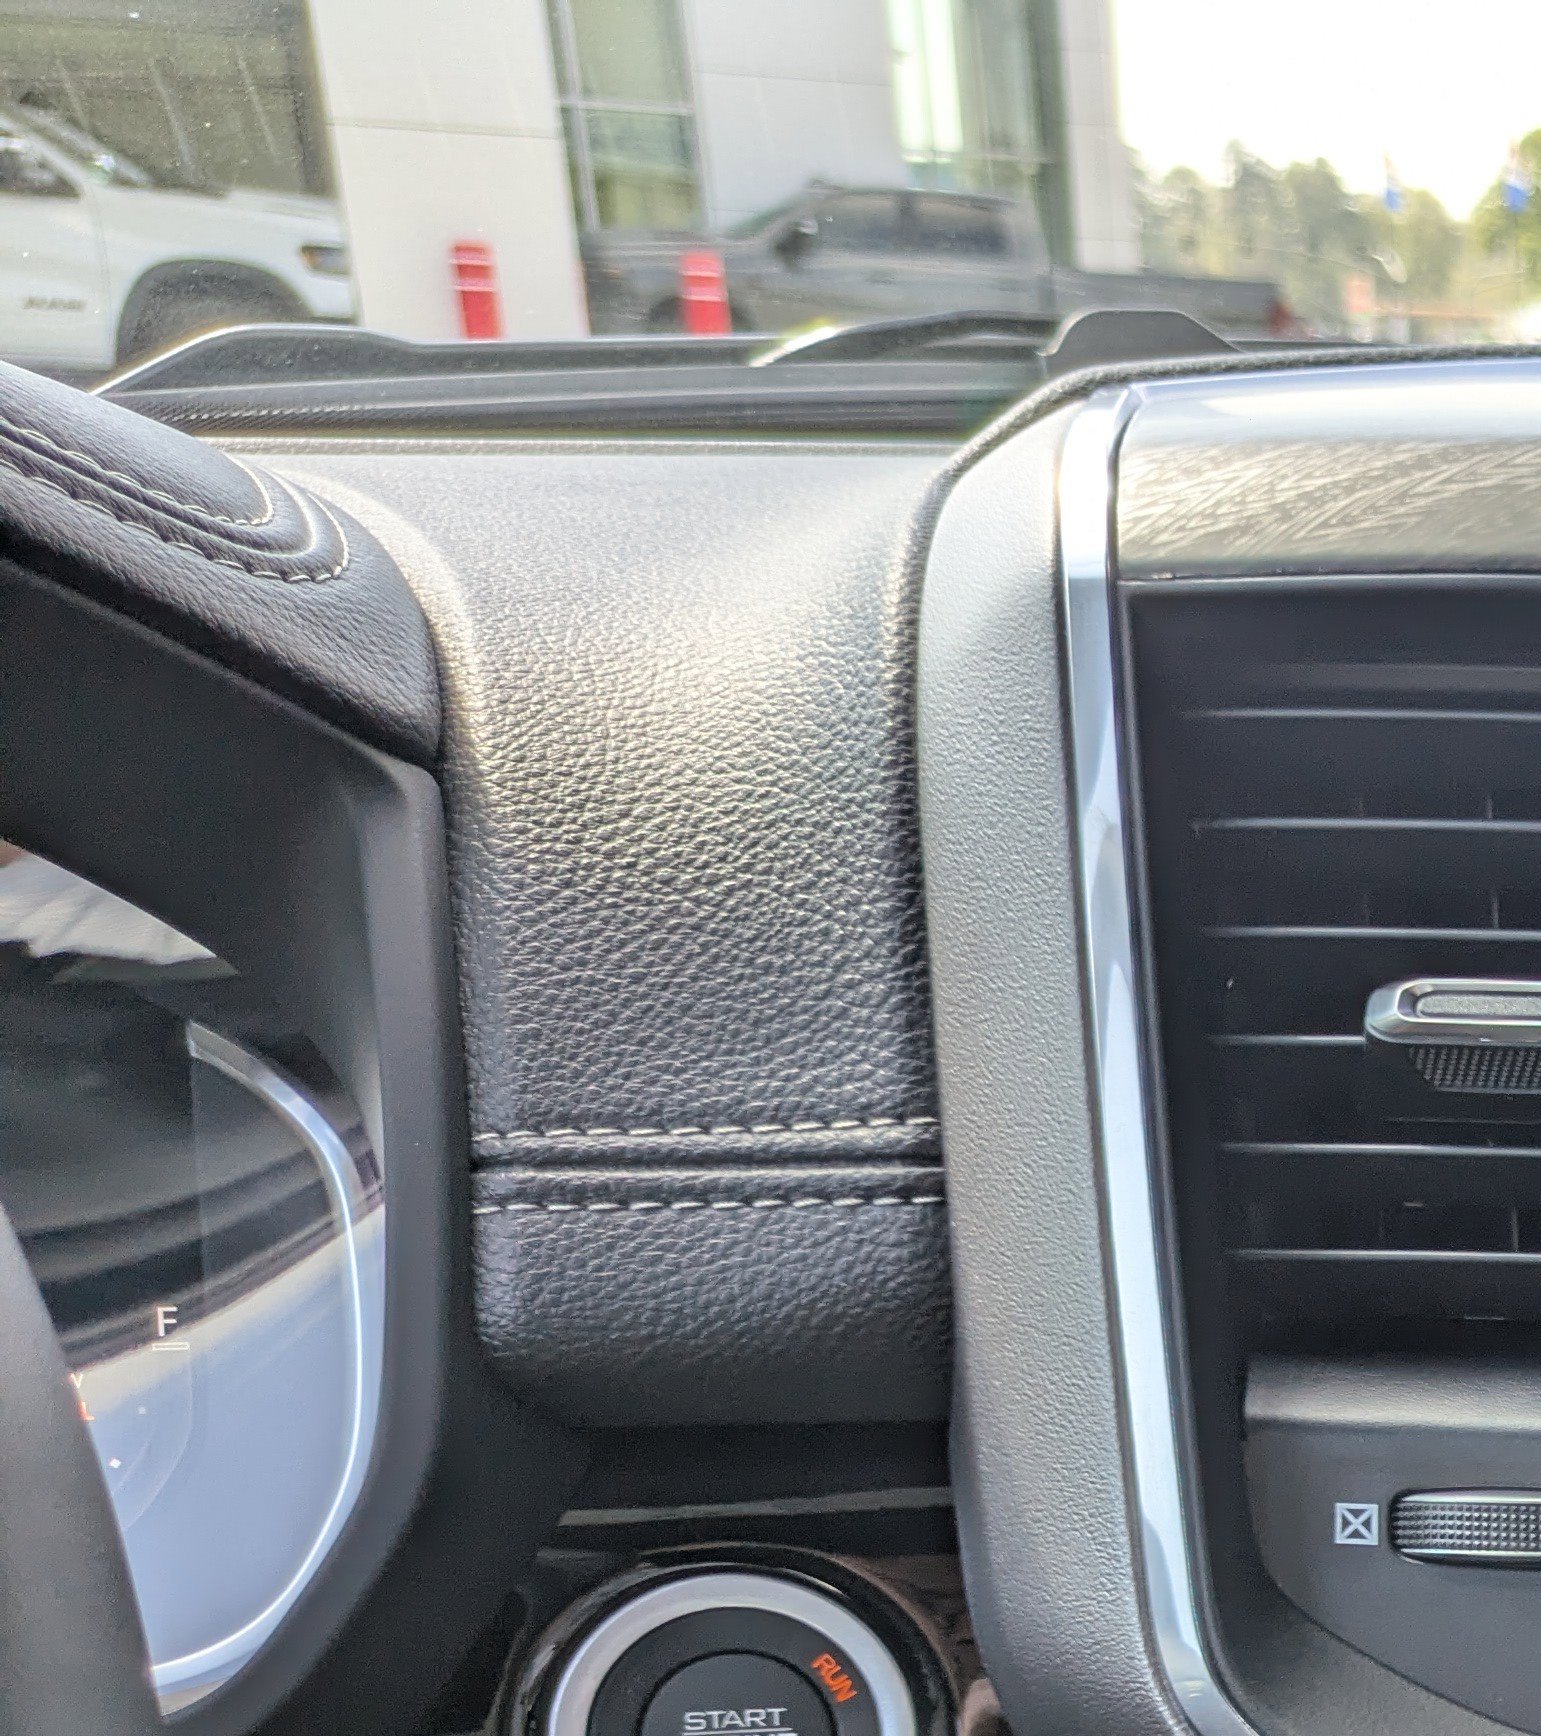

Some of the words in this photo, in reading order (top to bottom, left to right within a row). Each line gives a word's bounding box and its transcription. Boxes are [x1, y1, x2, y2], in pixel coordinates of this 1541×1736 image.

[157, 1306, 178, 1336] F
[810, 1653, 858, 1704] RUN
[683, 1707, 787, 1731] START
